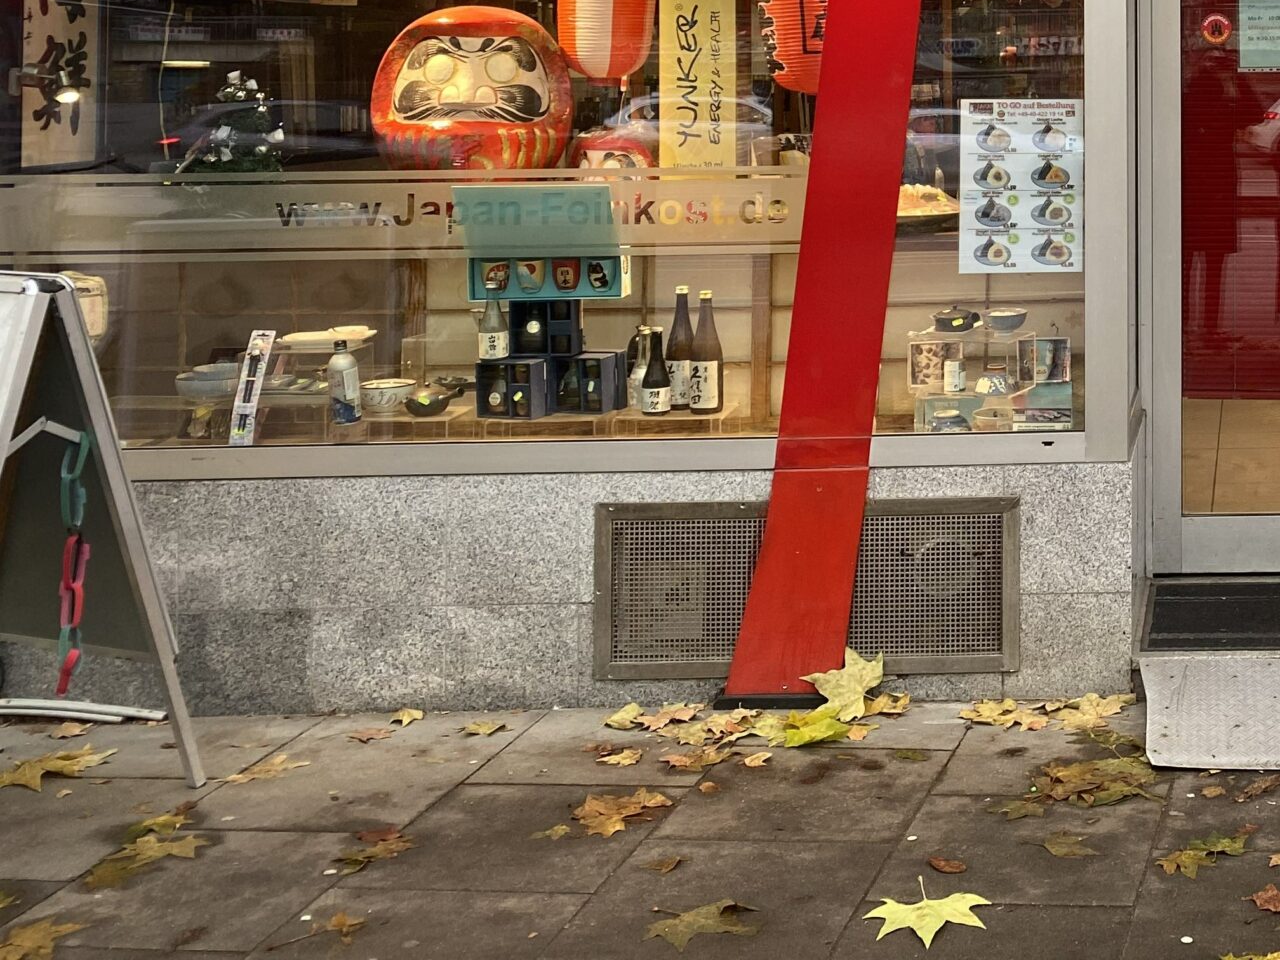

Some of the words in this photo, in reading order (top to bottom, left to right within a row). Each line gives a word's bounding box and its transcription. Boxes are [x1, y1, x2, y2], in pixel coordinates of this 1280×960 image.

[710, 11, 721, 64] HEALTH
[676, 5, 702, 147] YUNKER
[709, 81, 724, 145] ENERGY
[1022, 101, 1035, 109] auf
[1036, 102, 1075, 110] Bestellung
